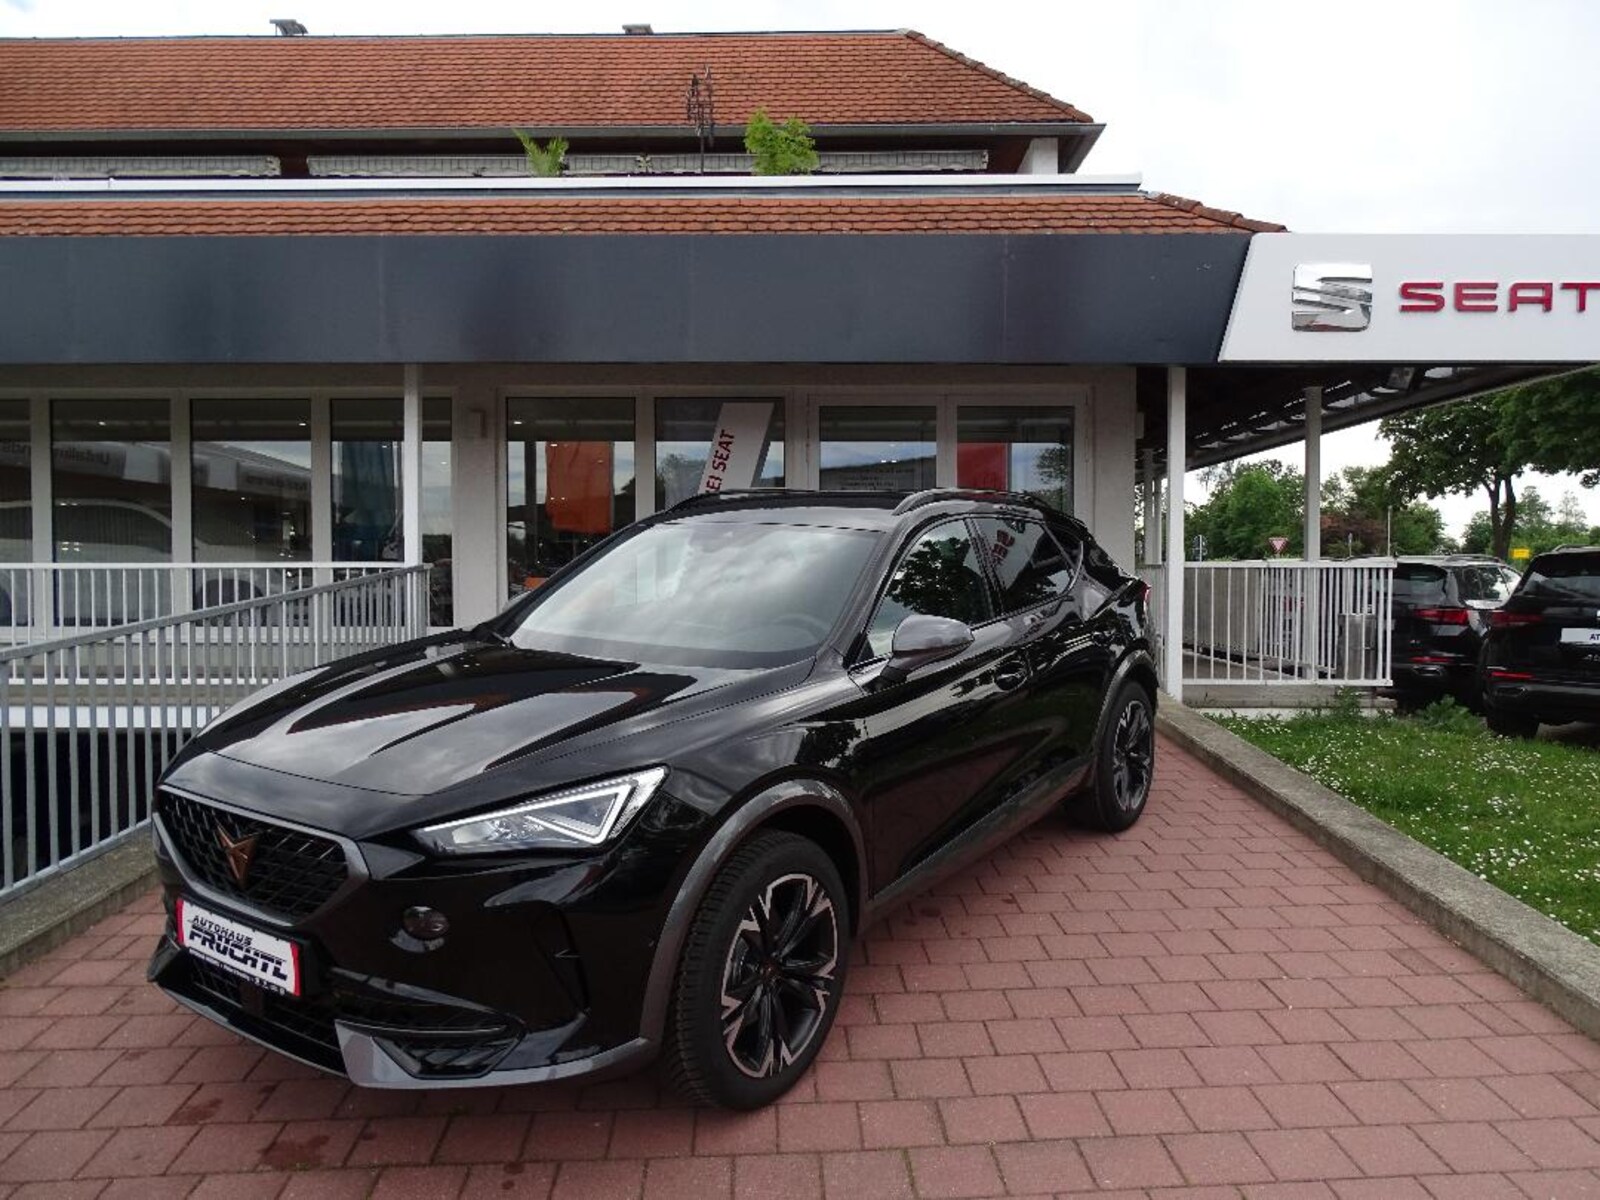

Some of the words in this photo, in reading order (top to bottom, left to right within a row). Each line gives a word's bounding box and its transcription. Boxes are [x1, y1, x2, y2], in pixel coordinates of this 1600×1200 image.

[1399, 282, 1600, 312] SEAT
[712, 429, 735, 472] SEAT
[706, 475, 722, 493] EI
[193, 915, 253, 946] AUTOHAUS
